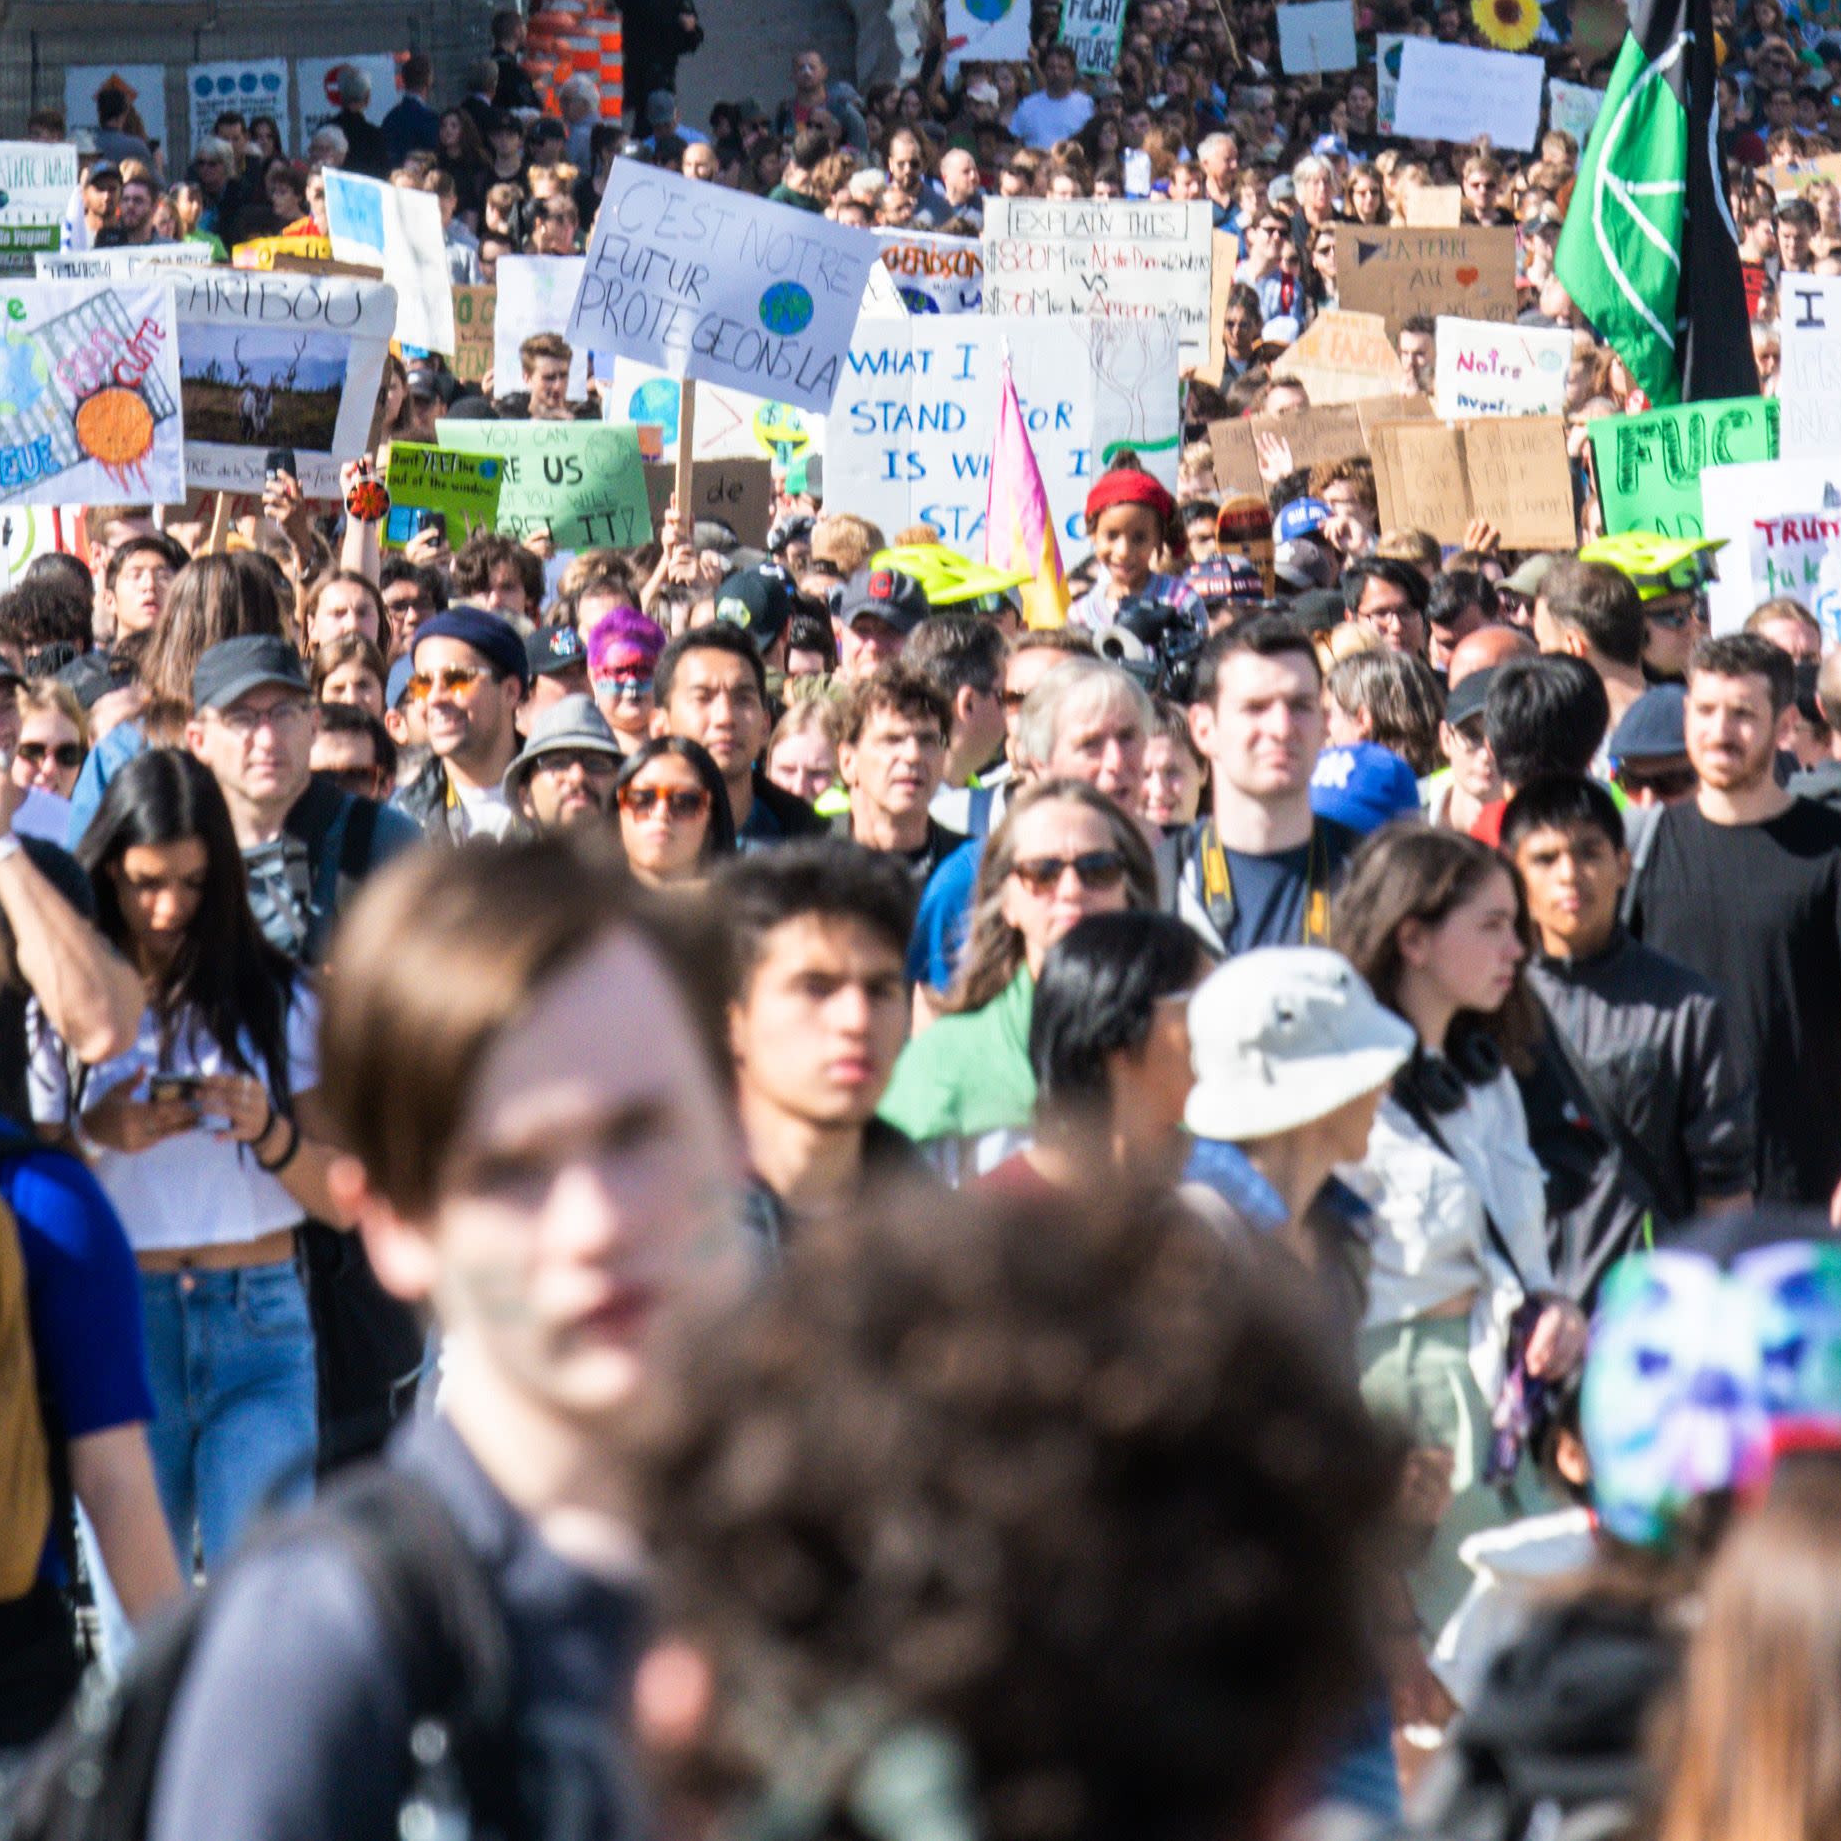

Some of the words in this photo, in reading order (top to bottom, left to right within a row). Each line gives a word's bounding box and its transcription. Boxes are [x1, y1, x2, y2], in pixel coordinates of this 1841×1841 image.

[1014, 210, 1114, 235] EXPLAIN
[1126, 209, 1177, 235] THIS
[593, 233, 710, 301] FUTUR
[741, 219, 859, 299] NOTRE
[1795, 289, 1826, 328] I
[793, 348, 844, 399] LA
[846, 347, 934, 376] WHAT
[951, 343, 980, 380] I
[849, 401, 967, 434] STAND
[542, 455, 585, 485] US
[879, 450, 927, 481] IS
[1067, 449, 1091, 478] I
[706, 475, 744, 504] de
